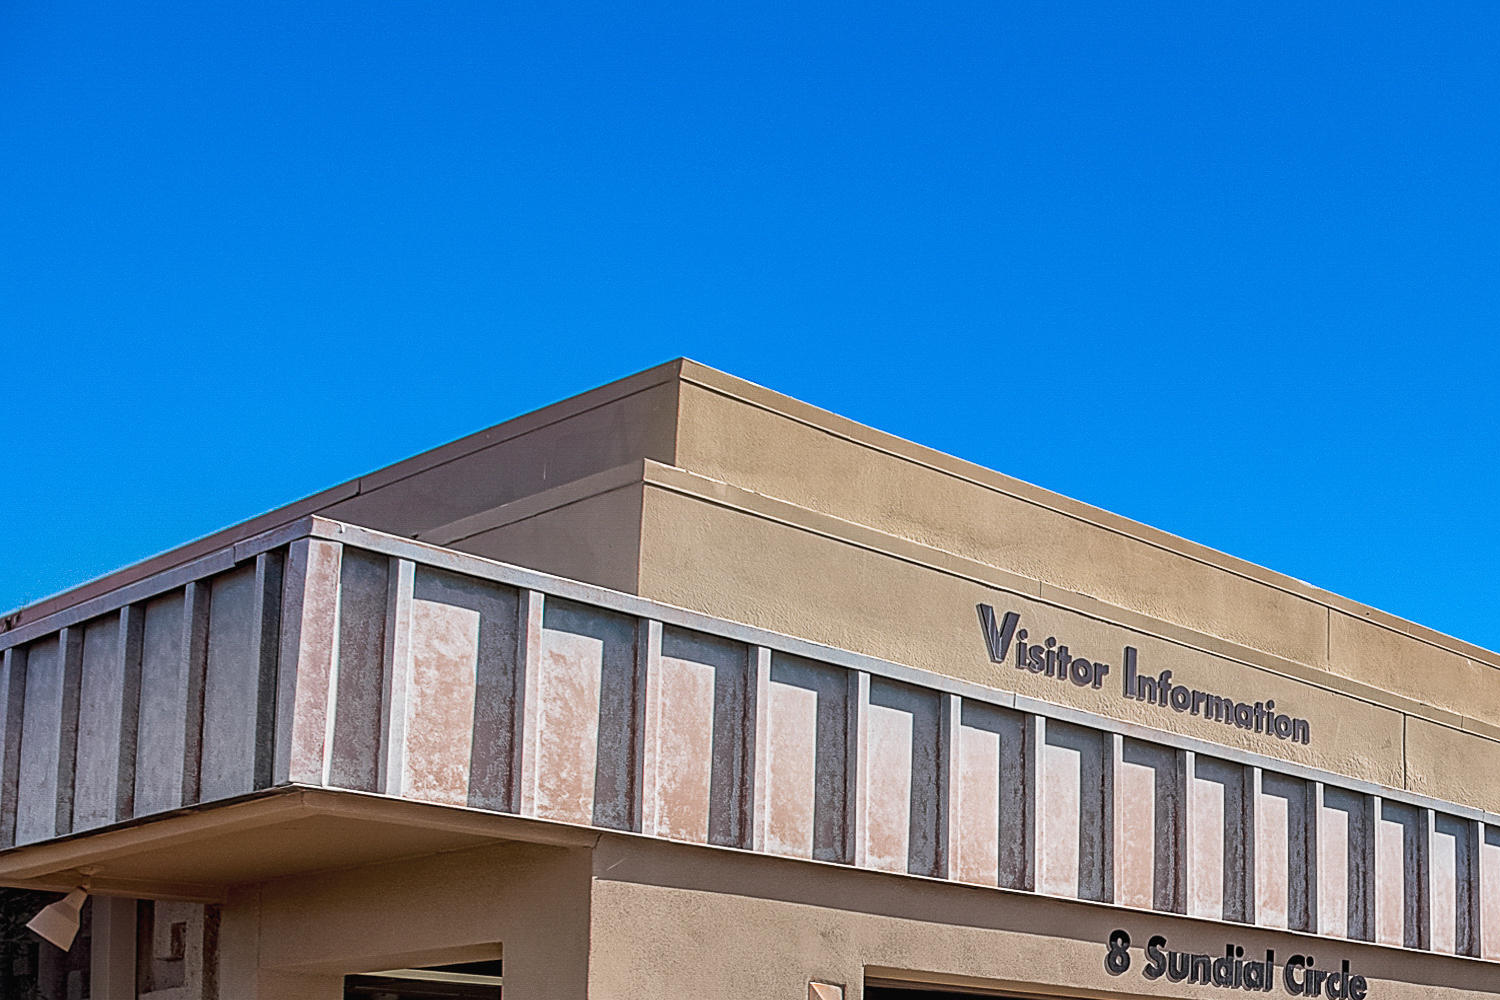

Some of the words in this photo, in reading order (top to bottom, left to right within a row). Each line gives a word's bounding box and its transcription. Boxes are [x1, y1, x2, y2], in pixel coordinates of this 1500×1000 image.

[976, 602, 1110, 689] Visitor
[1123, 645, 1311, 745] Information
[1104, 929, 1131, 976] 8
[1142, 935, 1275, 992] Sundial
